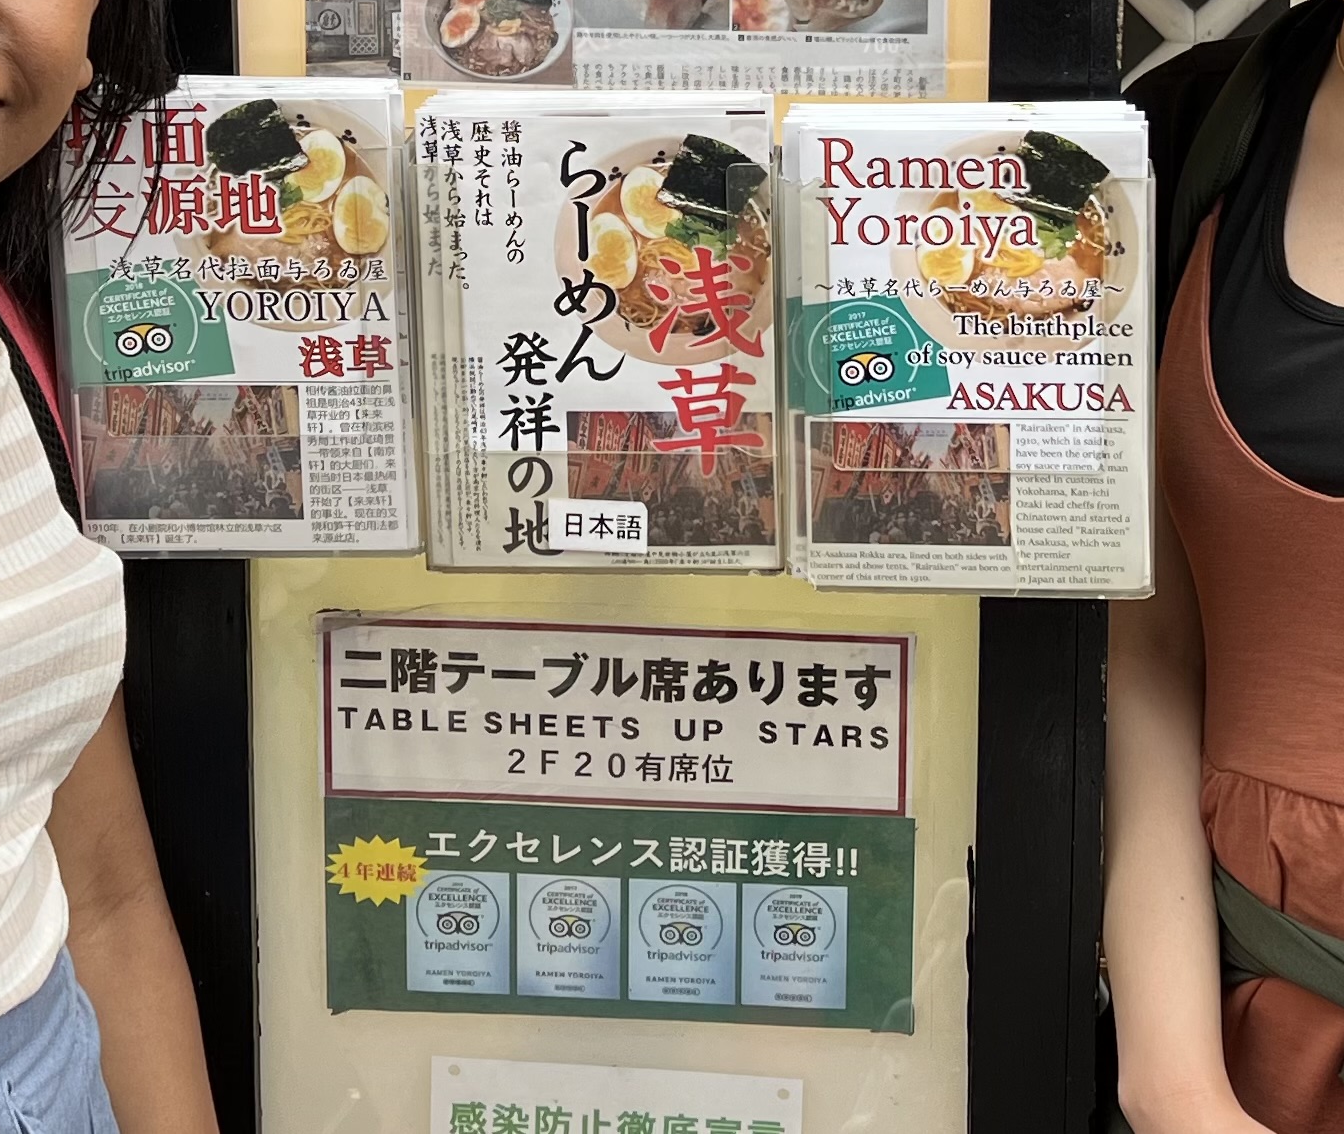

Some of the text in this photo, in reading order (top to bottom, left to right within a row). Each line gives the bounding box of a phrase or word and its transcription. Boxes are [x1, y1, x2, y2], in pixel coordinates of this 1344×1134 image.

[817, 136, 1028, 190] Ramen
[470, 120, 495, 227] 歴史それは
[500, 119, 527, 265] 醤油らーめんの
[69, 173, 283, 242] 发源地
[441, 119, 470, 290] 浅草から始まった。
[816, 196, 1039, 259] Yoroiya
[553, 139, 627, 384] らーめん
[103, 288, 168, 304] CERTIFICATE of
[99, 296, 176, 315] EXCELLENCE
[194, 290, 391, 322] YOROIYA
[848, 311, 866, 321] 2017
[827, 316, 890, 333] CERTIFICATE of
[953, 314, 1134, 340] The birthplace
[822, 324, 897, 345] EXCELLENCE
[298, 334, 394, 378] 浅草
[646, 246, 765, 476] 浅草
[907, 342, 1134, 369] of soy sauce ramen
[103, 360, 191, 382] tripadvisor
[946, 381, 1136, 413] ASAKUSA
[1072, 424, 1082, 433] in
[495, 331, 565, 556] 発祥の地
[1016, 437, 1116, 447] 1910, which is said to
[1016, 449, 1124, 460] have been the origin of
[1016, 463, 1032, 471] soy
[1097, 463, 1106, 472] A
[1107, 464, 1129, 472] man
[1016, 474, 1116, 485] worked in customs in
[1016, 487, 1110, 497] Yokohama, Kan-ichi
[1016, 500, 1120, 510] Ozaki lead cheffs from
[1016, 512, 1067, 522] Chinatown
[1069, 513, 1087, 522] and
[1089, 514, 1123, 523] started
[563, 513, 642, 541] 日本語
[1016, 525, 1044, 534] house
[1046, 525, 1073, 534] called
[1016, 538, 1121, 548] in Asakusa, which was
[859, 550, 885, 559] Rokku
[887, 552, 907, 560] area,
[909, 551, 930, 560] lined
[945, 551, 963, 561] both
[966, 552, 987, 561] sides
[989, 552, 1008, 561] with
[1034, 550, 1071, 560] premier
[810, 561, 843, 570] theaters
[845, 561, 860, 570] and
[863, 561, 884, 570] show
[979, 563, 998, 572] born
[1016, 563, 1125, 574] entertainment quarters
[817, 573, 844, 581] corner
[846, 572, 854, 581] of
[856, 572, 872, 581] this
[873, 573, 897, 581] street
[899, 573, 908, 581] in
[1028, 575, 1054, 585] Japan
[1068, 575, 1088, 584] that
[339, 646, 893, 712] 二階テーブル席あります
[337, 706, 891, 752] TABLE SHEETS UP STARS
[507, 748, 735, 786] 2F20有席位
[424, 828, 861, 880] エクセレンス認証獲得!!
[337, 860, 418, 885] 4年連続
[428, 894, 489, 903] EXCELLENCE
[542, 898, 598, 907] EXCELLENCE
[652, 904, 710, 914] EXCELLENCE
[767, 905, 823, 915] EXCELLENCE
[424, 938, 490, 954] tripadvisor
[536, 941, 601, 956] tripadvisor
[646, 949, 713, 963] tripadvisor
[760, 949, 826, 963] tripadvisor
[425, 969, 454, 977] RAMEN
[535, 970, 605, 980] RAMEN YOROIYA
[645, 975, 717, 985] RAMEN YOROIYA
[760, 974, 789, 983] RAMEN
